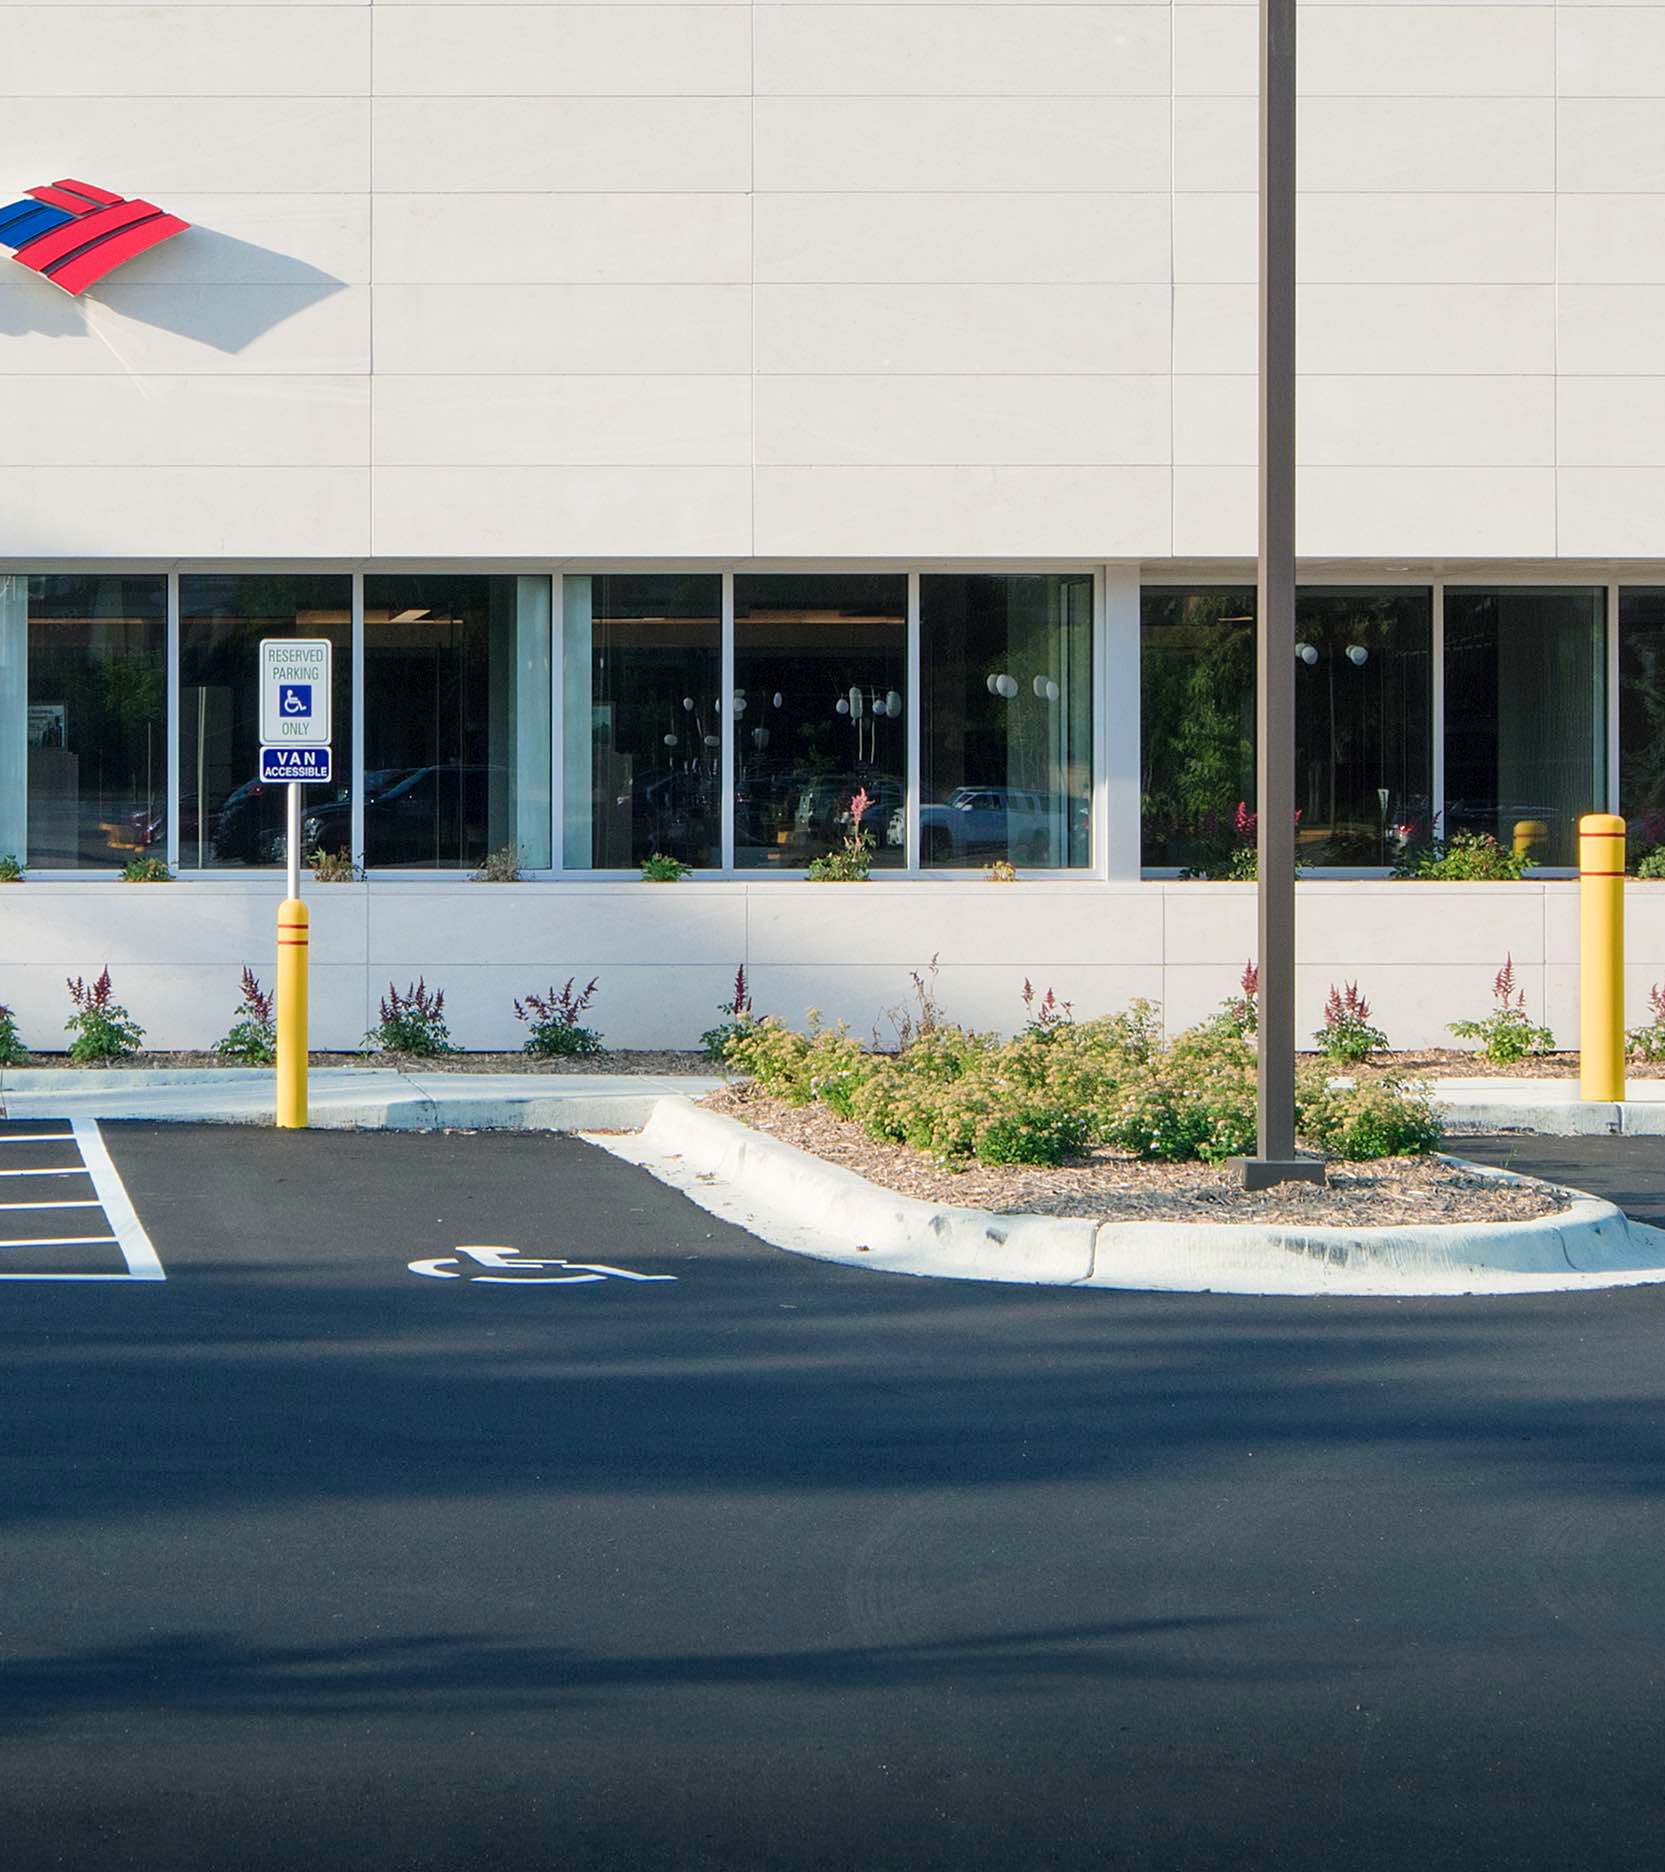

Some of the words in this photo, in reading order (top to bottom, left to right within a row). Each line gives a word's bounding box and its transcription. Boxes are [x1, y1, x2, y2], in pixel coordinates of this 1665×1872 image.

[268, 649, 323, 662] RESERVED
[272, 667, 319, 680] PARKING
[282, 722, 310, 736] ONLY
[277, 751, 316, 766] VAN
[265, 766, 327, 777] ACCESSIBLE
